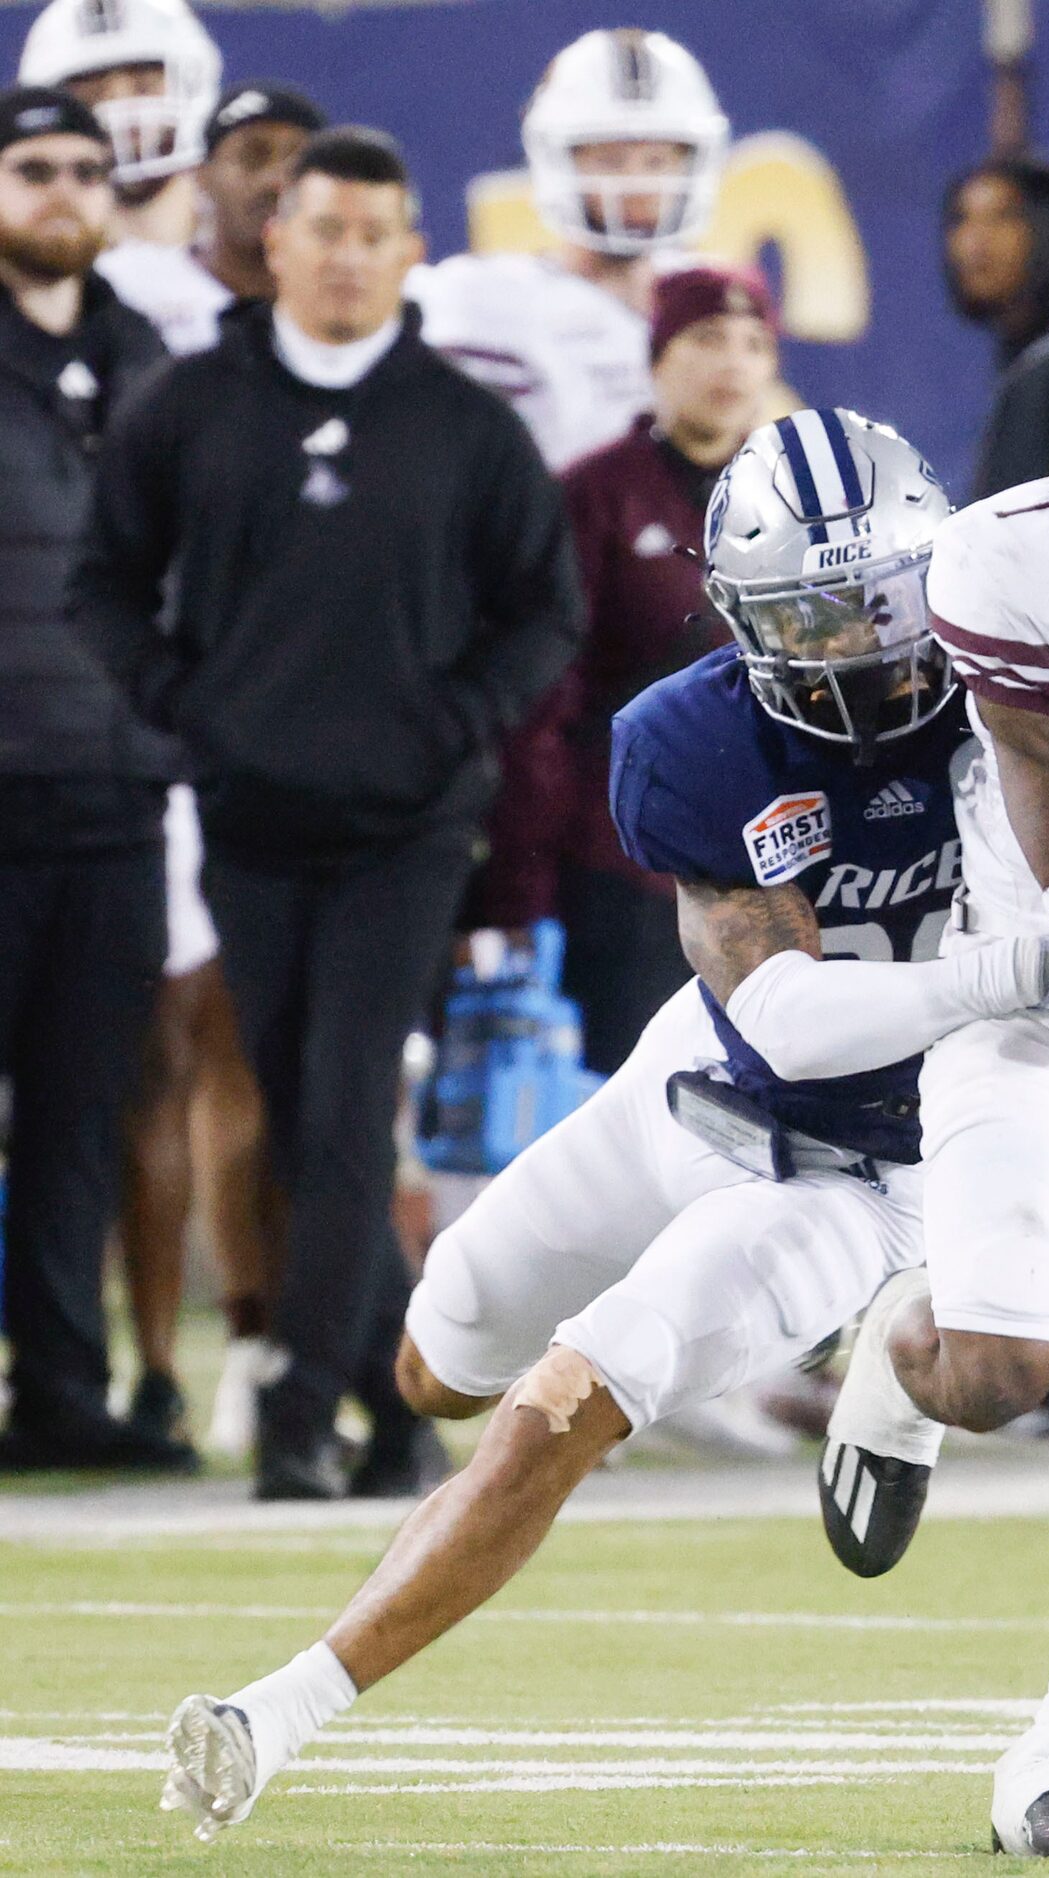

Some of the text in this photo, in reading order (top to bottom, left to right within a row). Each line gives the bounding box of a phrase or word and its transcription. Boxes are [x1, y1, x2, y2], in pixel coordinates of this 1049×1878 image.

[818, 542, 873, 570] RICE
[863, 801, 926, 821] adidas
[753, 808, 827, 859] F1RST
[759, 830, 832, 871] RESPONDER
[814, 837, 963, 909] RICE
